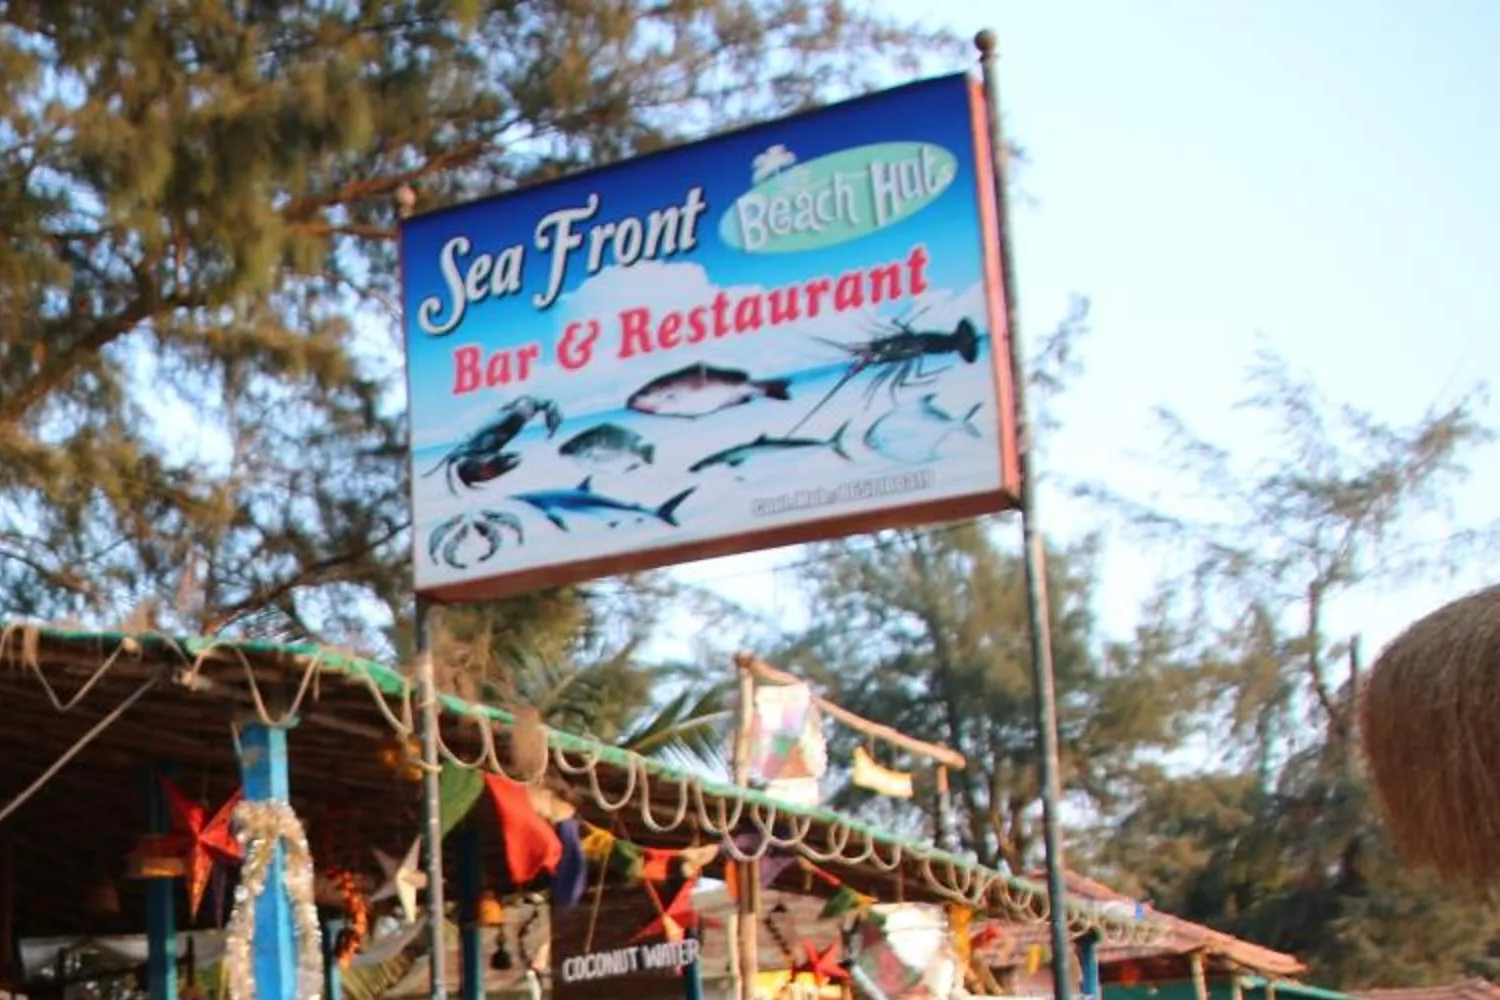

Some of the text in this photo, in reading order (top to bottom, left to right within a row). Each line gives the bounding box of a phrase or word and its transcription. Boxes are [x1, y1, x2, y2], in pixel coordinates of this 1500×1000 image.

[419, 187, 705, 335] Sea Front
[737, 171, 857, 253] Beach
[451, 245, 929, 396] Bar & Restaurant
[563, 940, 699, 982] COCONUT WATER
